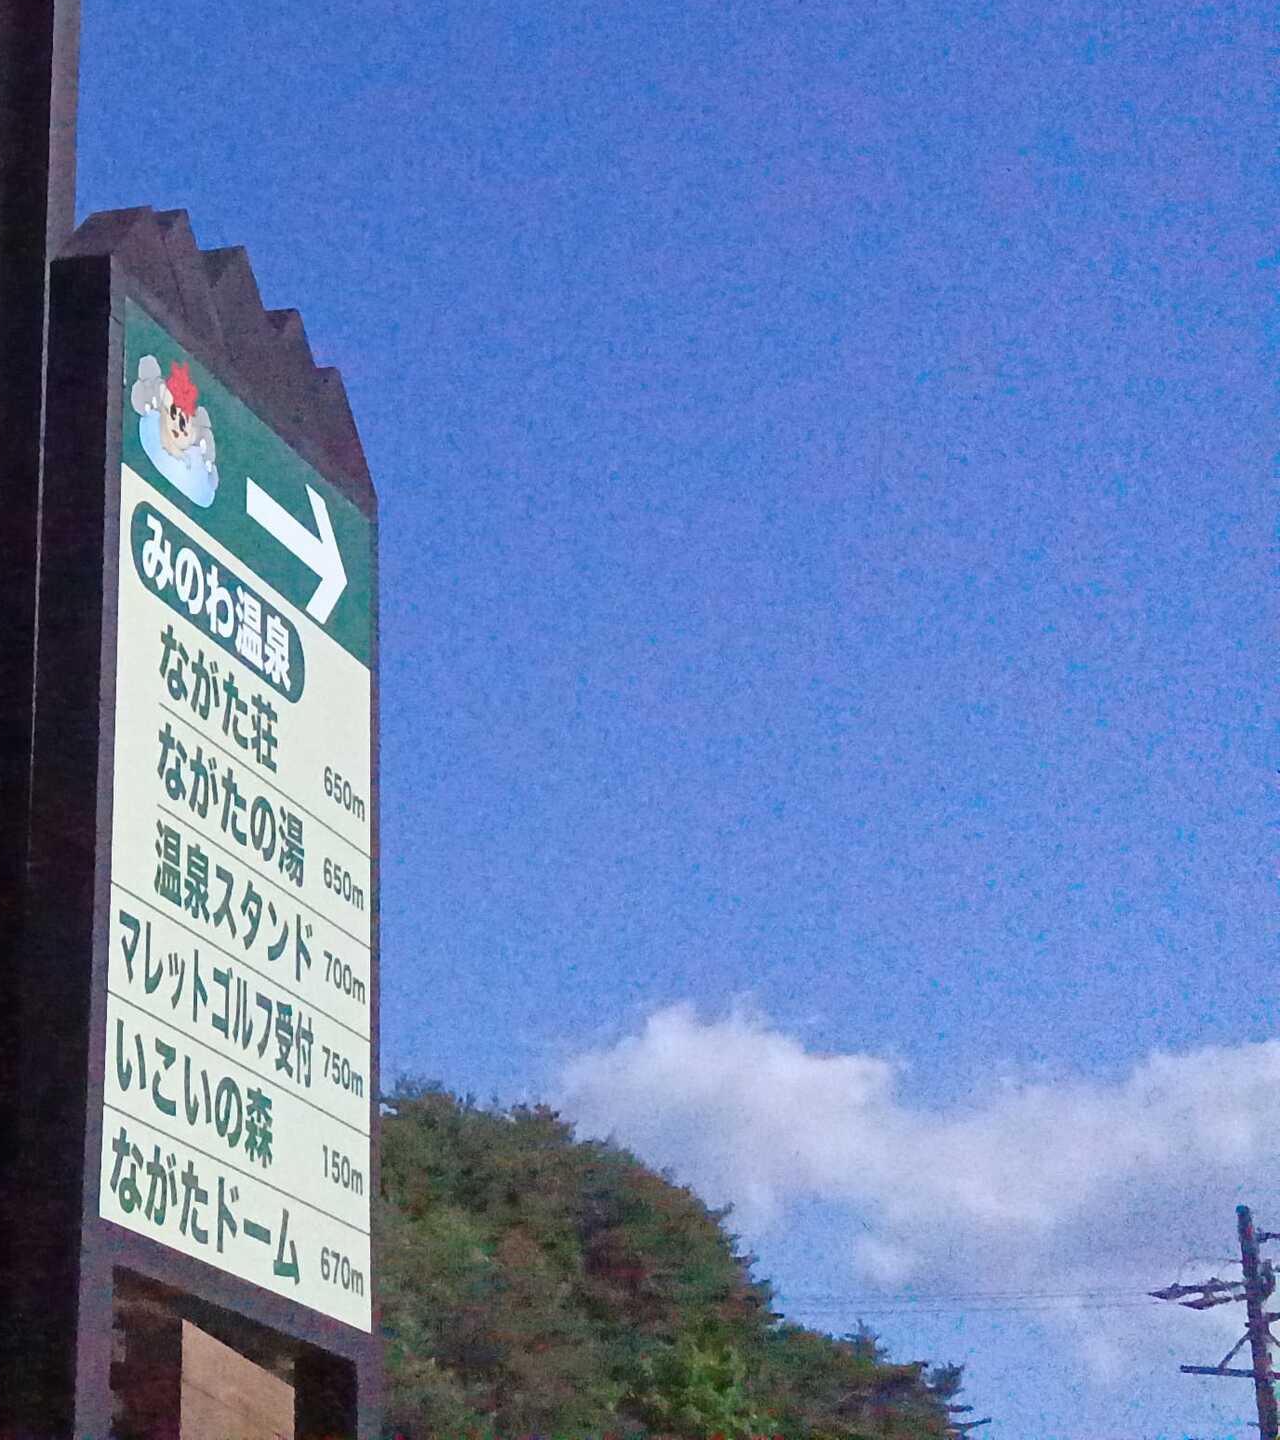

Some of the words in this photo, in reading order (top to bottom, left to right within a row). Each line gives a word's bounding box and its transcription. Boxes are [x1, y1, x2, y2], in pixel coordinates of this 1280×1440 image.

[142, 513, 292, 692] みのわ温泉
[160, 623, 279, 774] ながた荘
[323, 765, 367, 823] 650m
[157, 722, 305, 888] ながたの湯
[322, 857, 365, 912] 650m
[118, 909, 314, 1089] マレットゴルフ受付
[321, 1046, 364, 1099] 750m
[154, 819, 312, 982] 温泉スタンド
[323, 950, 366, 1006] 700m
[115, 1018, 274, 1169] いこいの森
[322, 1144, 364, 1196] 150m
[109, 1126, 301, 1286] ながたドーム
[320, 1246, 364, 1297] 670m
